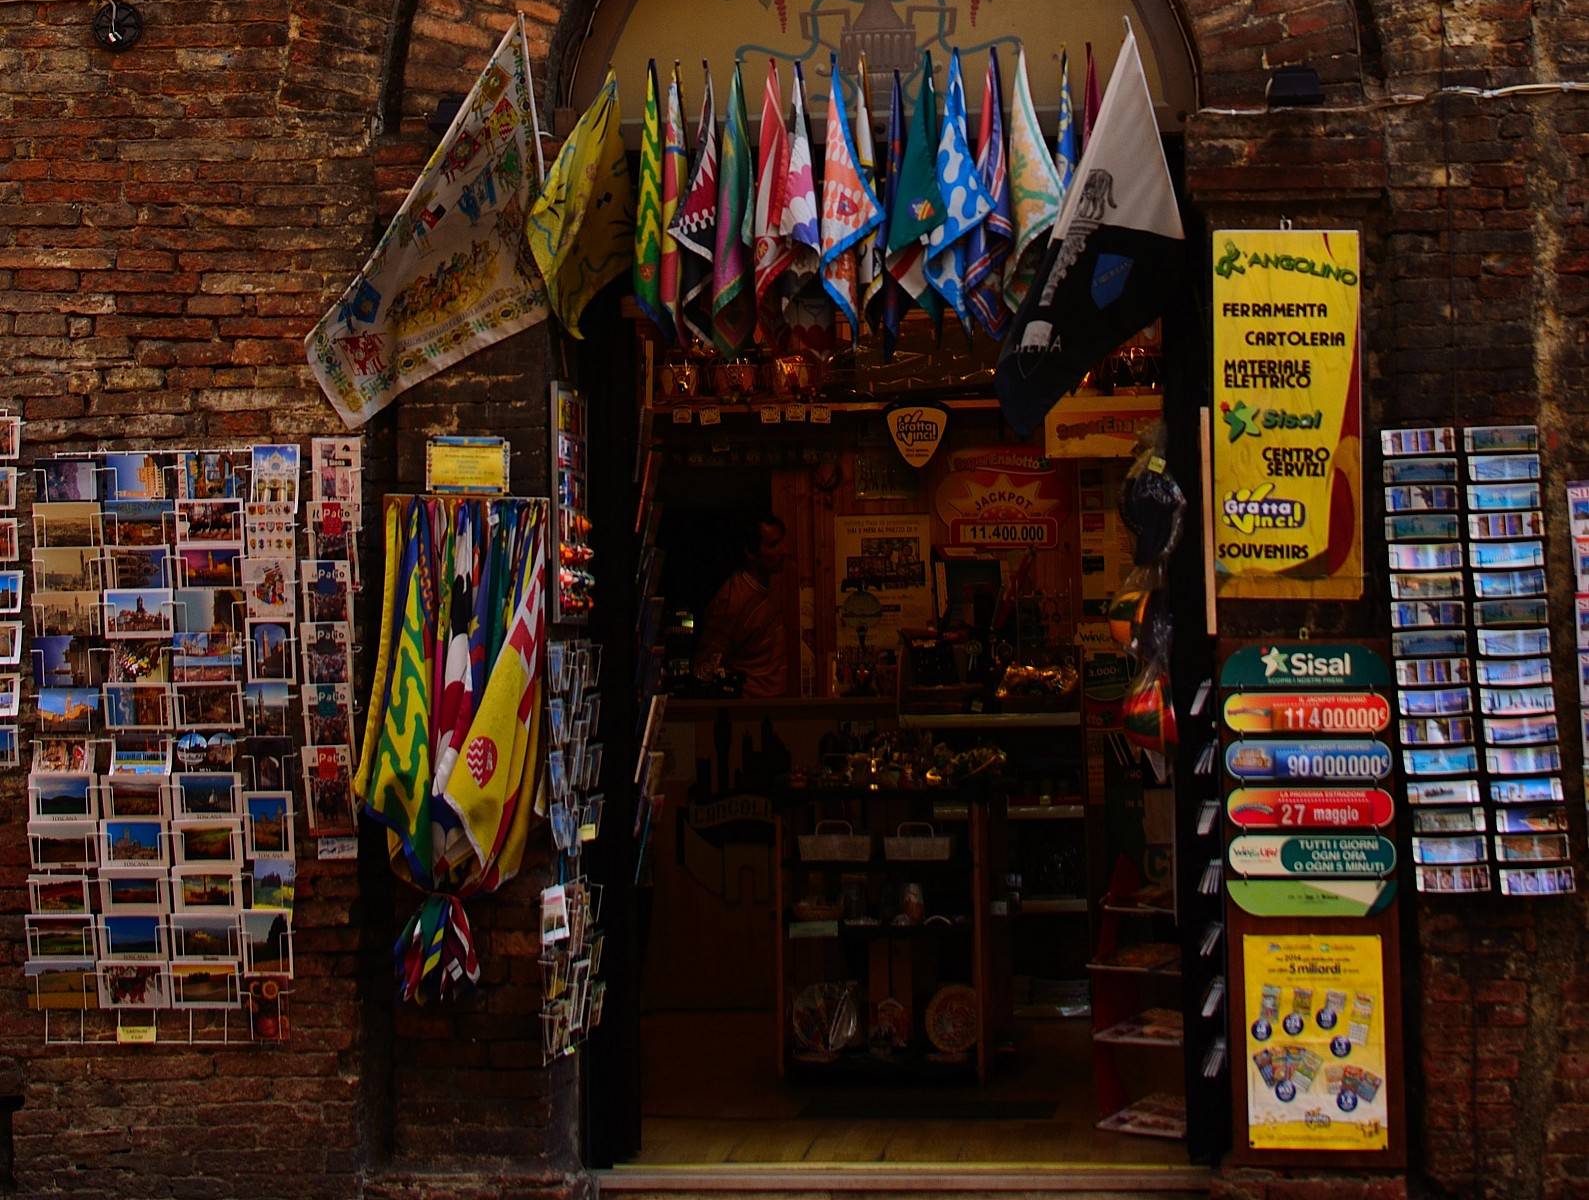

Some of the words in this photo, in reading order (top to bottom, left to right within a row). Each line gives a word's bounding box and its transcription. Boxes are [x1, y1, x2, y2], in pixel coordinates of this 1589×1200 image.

[1222, 302, 1327, 318] FERRAMENTA
[1244, 330, 1346, 347] CARTOLERIA
[1224, 359, 1311, 375] MATERIALE
[1224, 373, 1311, 389] ELETTRICO
[898, 420, 932, 432] Gratta
[1262, 409, 1323, 430] Sisal
[1262, 447, 1330, 462] CENTRO
[1267, 462, 1326, 477] SERVIZI
[975, 491, 1033, 511] JACKPOT
[1224, 499, 1292, 515] Gratta
[322, 508, 350, 519] Palio
[969, 525, 1044, 541] 11.400.000
[1218, 543, 1309, 559] SOUVENIRS
[318, 569, 345, 580] Palio
[317, 630, 345, 641] Palio
[1290, 652, 1352, 677] Sisal
[318, 691, 345, 702] Palio
[1285, 706, 1387, 729] 11.400.000€
[319, 753, 346, 764] Palio
[1287, 754, 1388, 777] 90.000.000€
[1281, 803, 1306, 825] 27
[1313, 804, 1360, 825] maggio
[1299, 839, 1332, 851] TUTTI
[1339, 839, 1379, 850] GIORNI
[1311, 850, 1340, 860] OGNI
[1342, 850, 1367, 860] ORA
[1294, 861, 1304, 871] O
[1305, 861, 1335, 871] OGNI
[1336, 861, 1343, 871] 5
[1345, 861, 1385, 871] MINUTI
[1289, 963, 1296, 974] 5
[1297, 962, 1341, 974] miliardi
